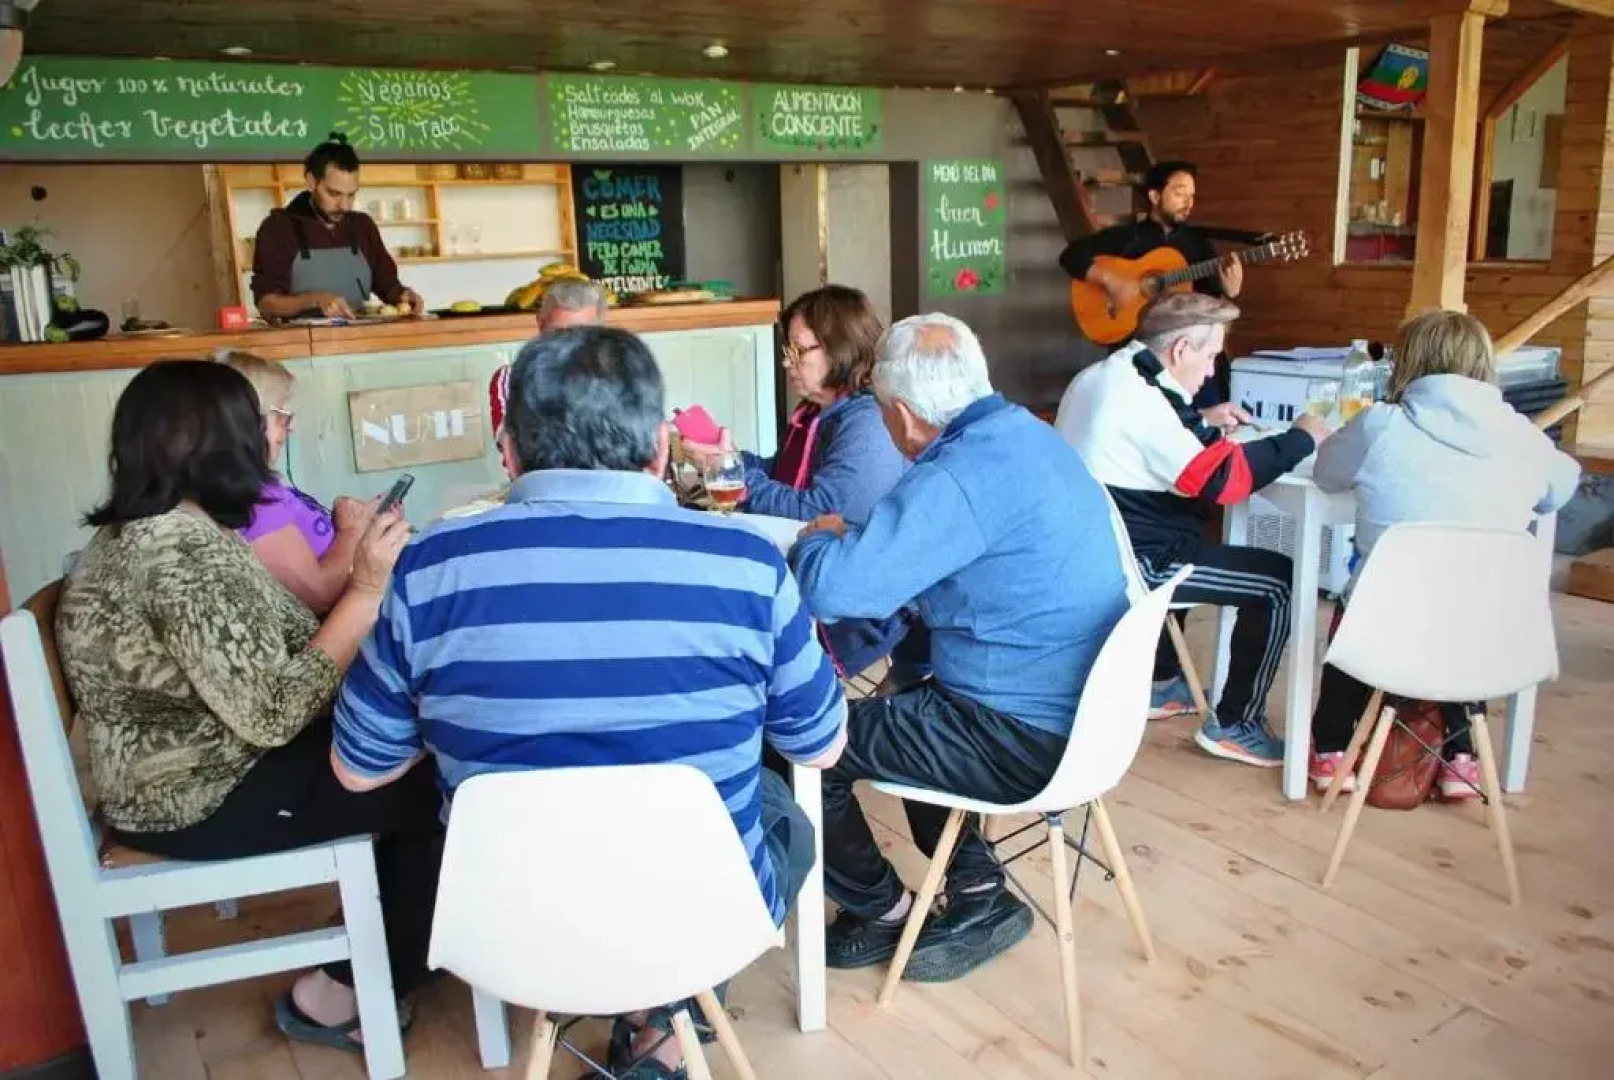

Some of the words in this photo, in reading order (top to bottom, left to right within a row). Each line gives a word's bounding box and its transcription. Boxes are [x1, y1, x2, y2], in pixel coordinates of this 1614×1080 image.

[22, 66, 106, 106] Jugos
[358, 78, 452, 105] Veganos
[143, 109, 309, 148] Vegetales
[369, 115, 405, 140] Sin
[772, 112, 863, 137] CONSCIENTE
[963, 163, 980, 183] DEL
[583, 175, 663, 203] COMER
[601, 202, 619, 219] ES
[621, 199, 647, 219] UNA
